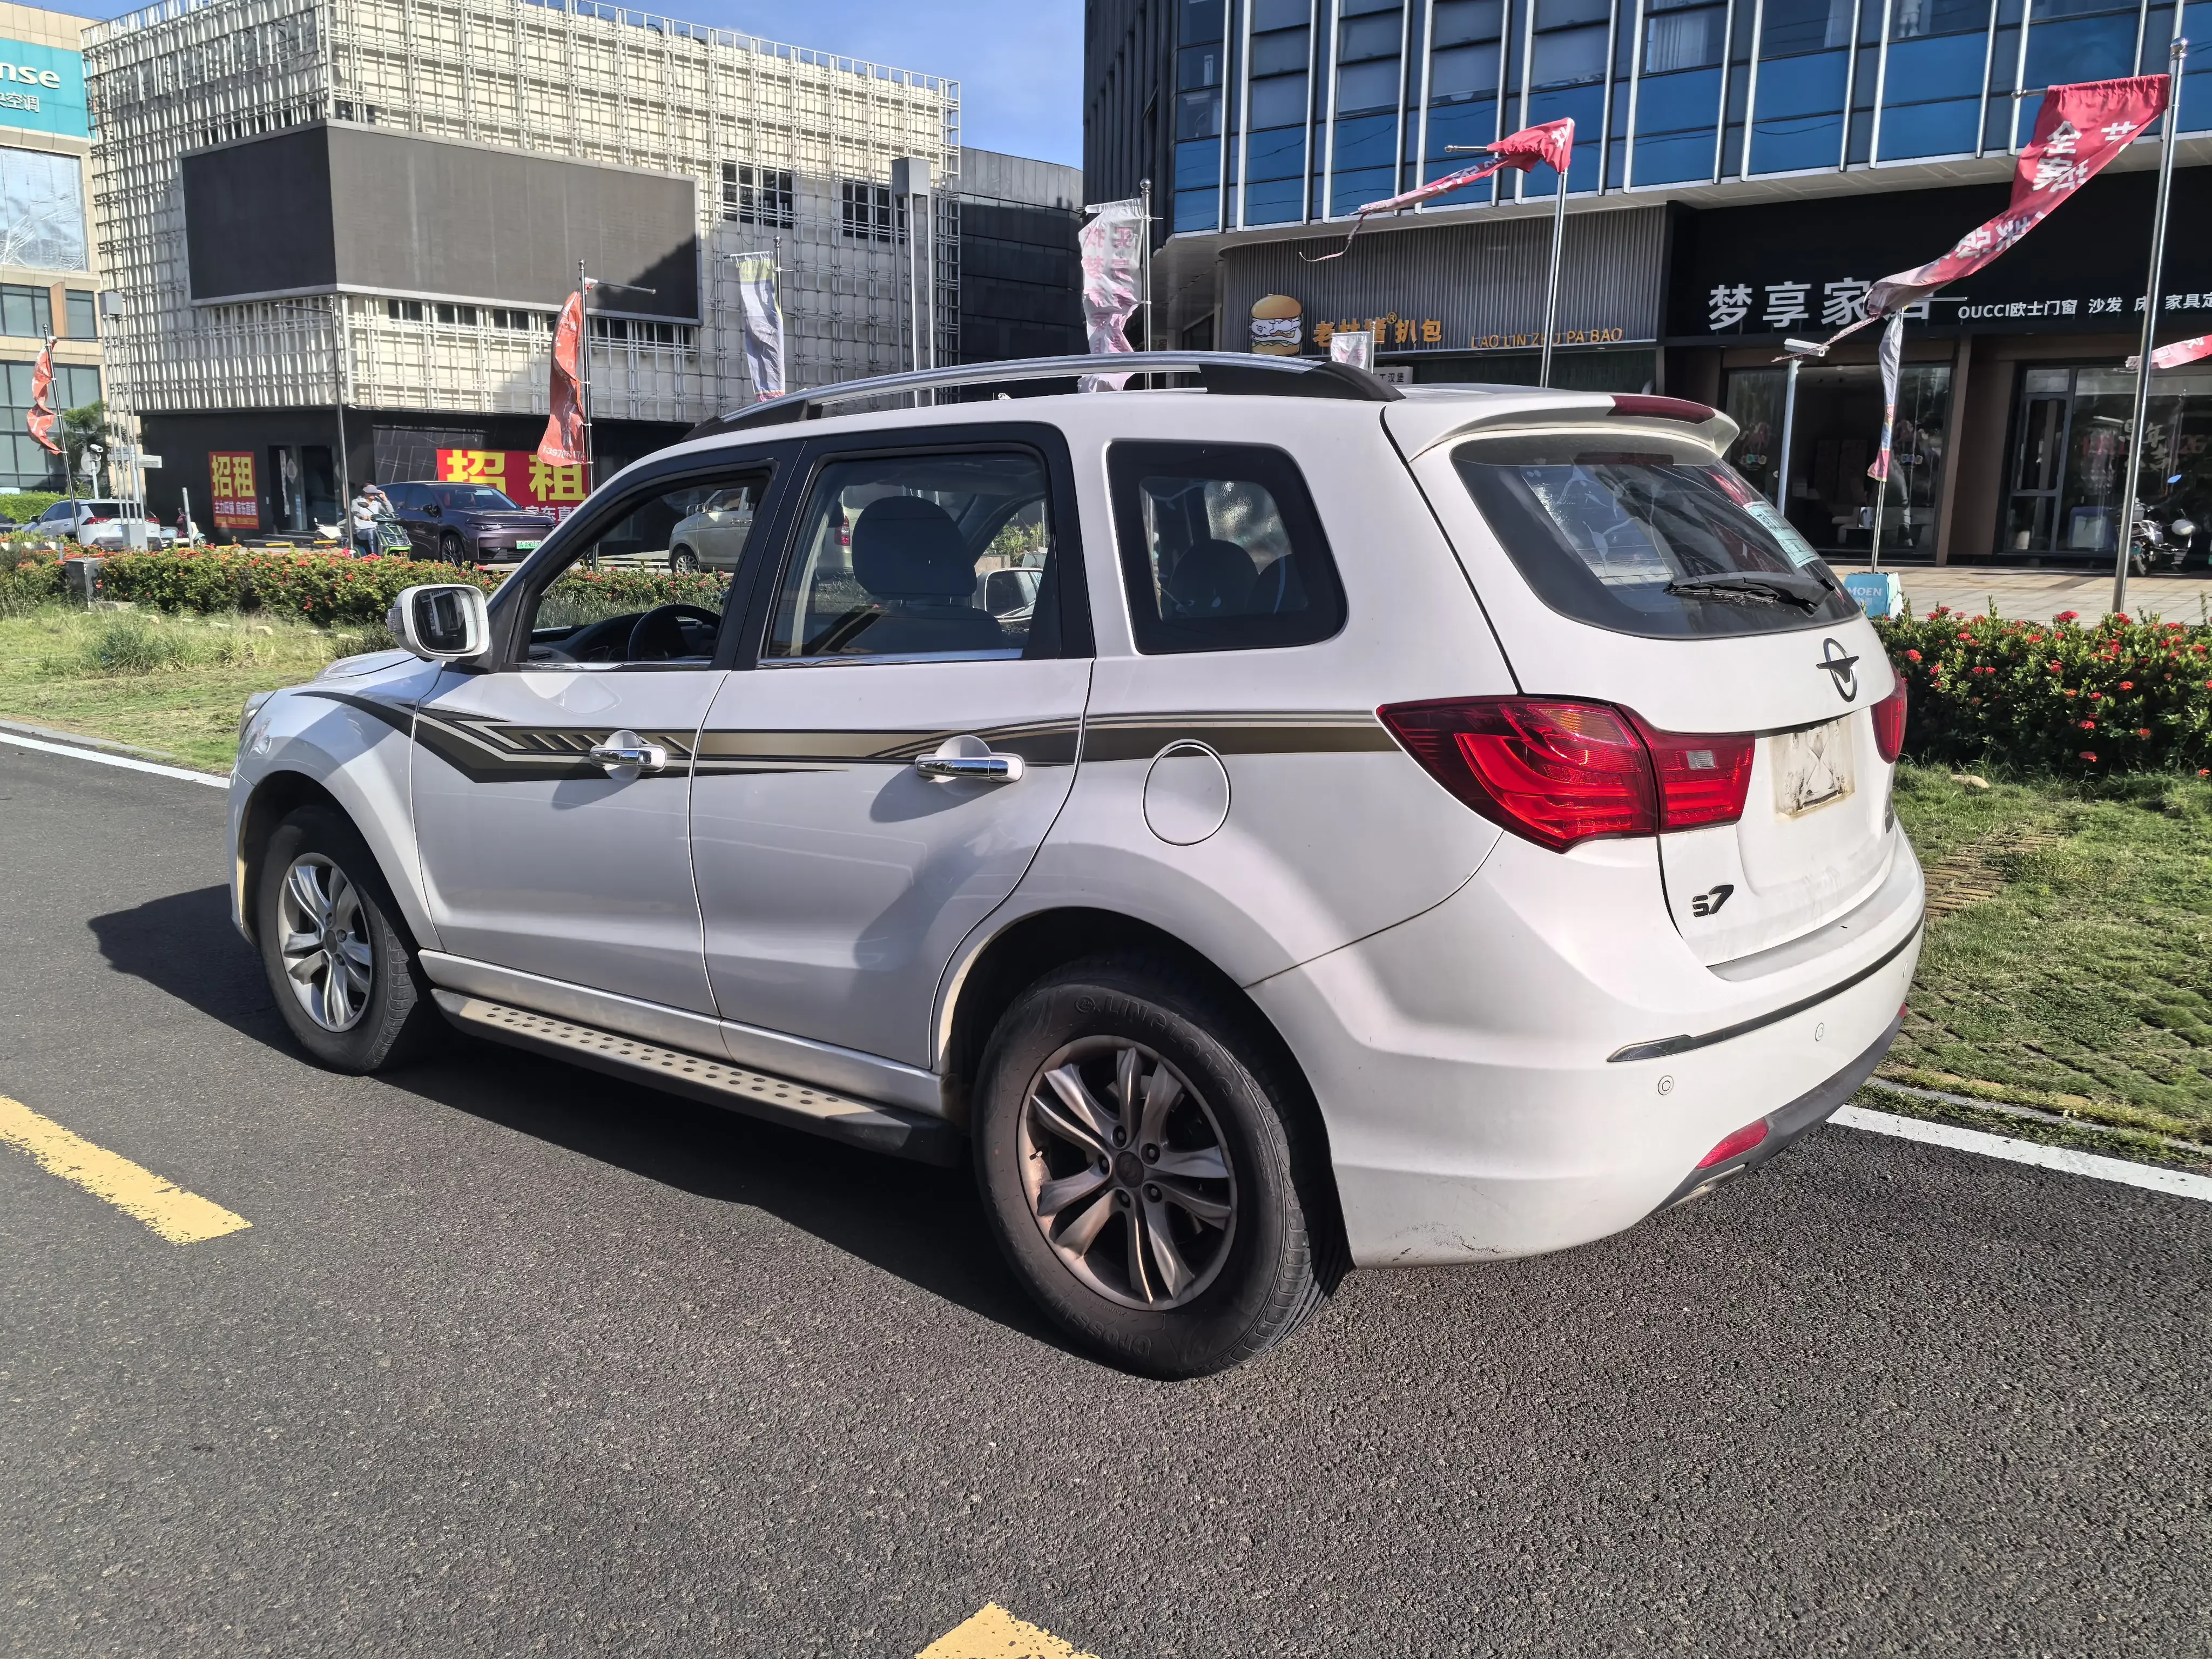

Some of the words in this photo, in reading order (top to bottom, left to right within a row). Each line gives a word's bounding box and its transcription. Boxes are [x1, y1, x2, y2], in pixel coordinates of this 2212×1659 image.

[2088, 296, 2123, 314] 沙发
[1471, 334, 1499, 349] LAO
[1504, 333, 1526, 347] LIN
[1567, 330, 1585, 345] PA
[1590, 327, 1623, 343] BAO
[212, 455, 255, 497] 招租
[447, 449, 586, 502] 招租
[1847, 587, 1882, 596] MOEN
[1692, 884, 1734, 918] S7
